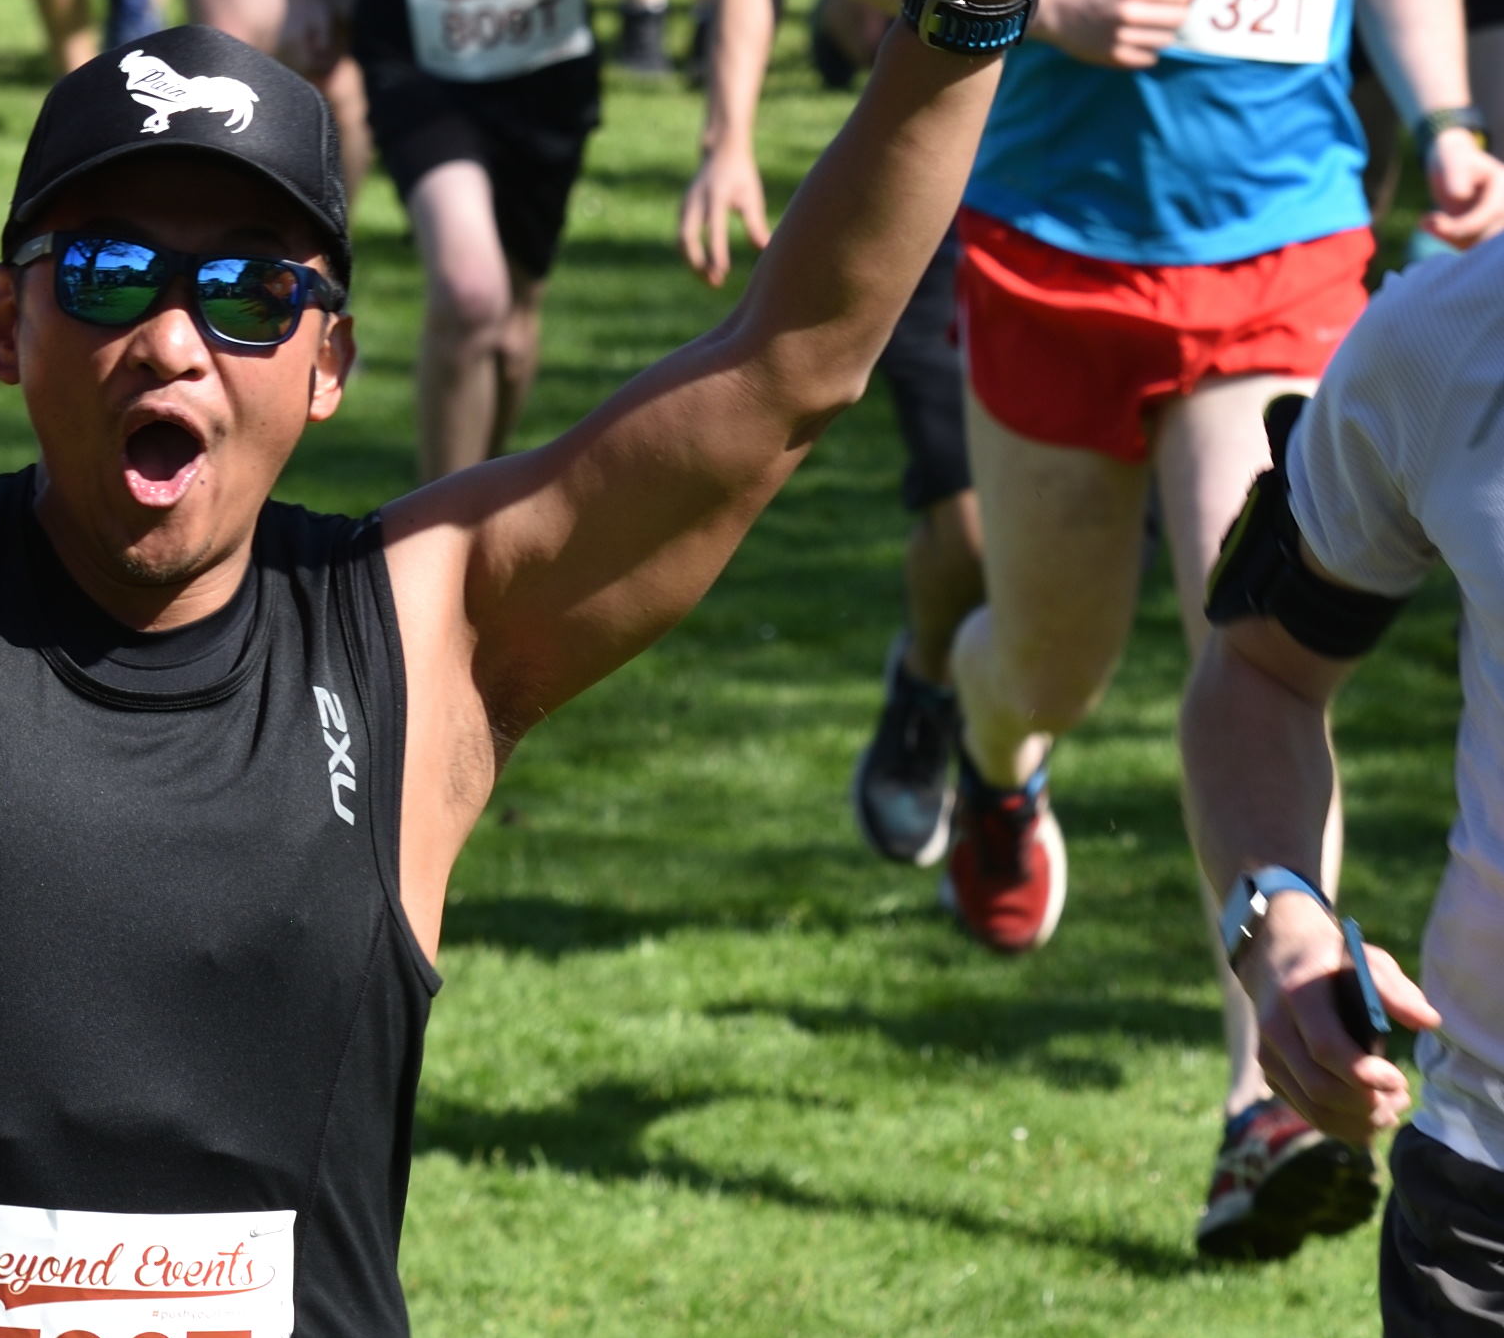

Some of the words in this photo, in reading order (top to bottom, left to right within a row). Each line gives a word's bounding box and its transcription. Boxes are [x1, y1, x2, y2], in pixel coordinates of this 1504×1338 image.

[134, 69, 186, 97] Pain
[312, 685, 356, 826] 2XU
[134, 1242, 255, 1288] Events
